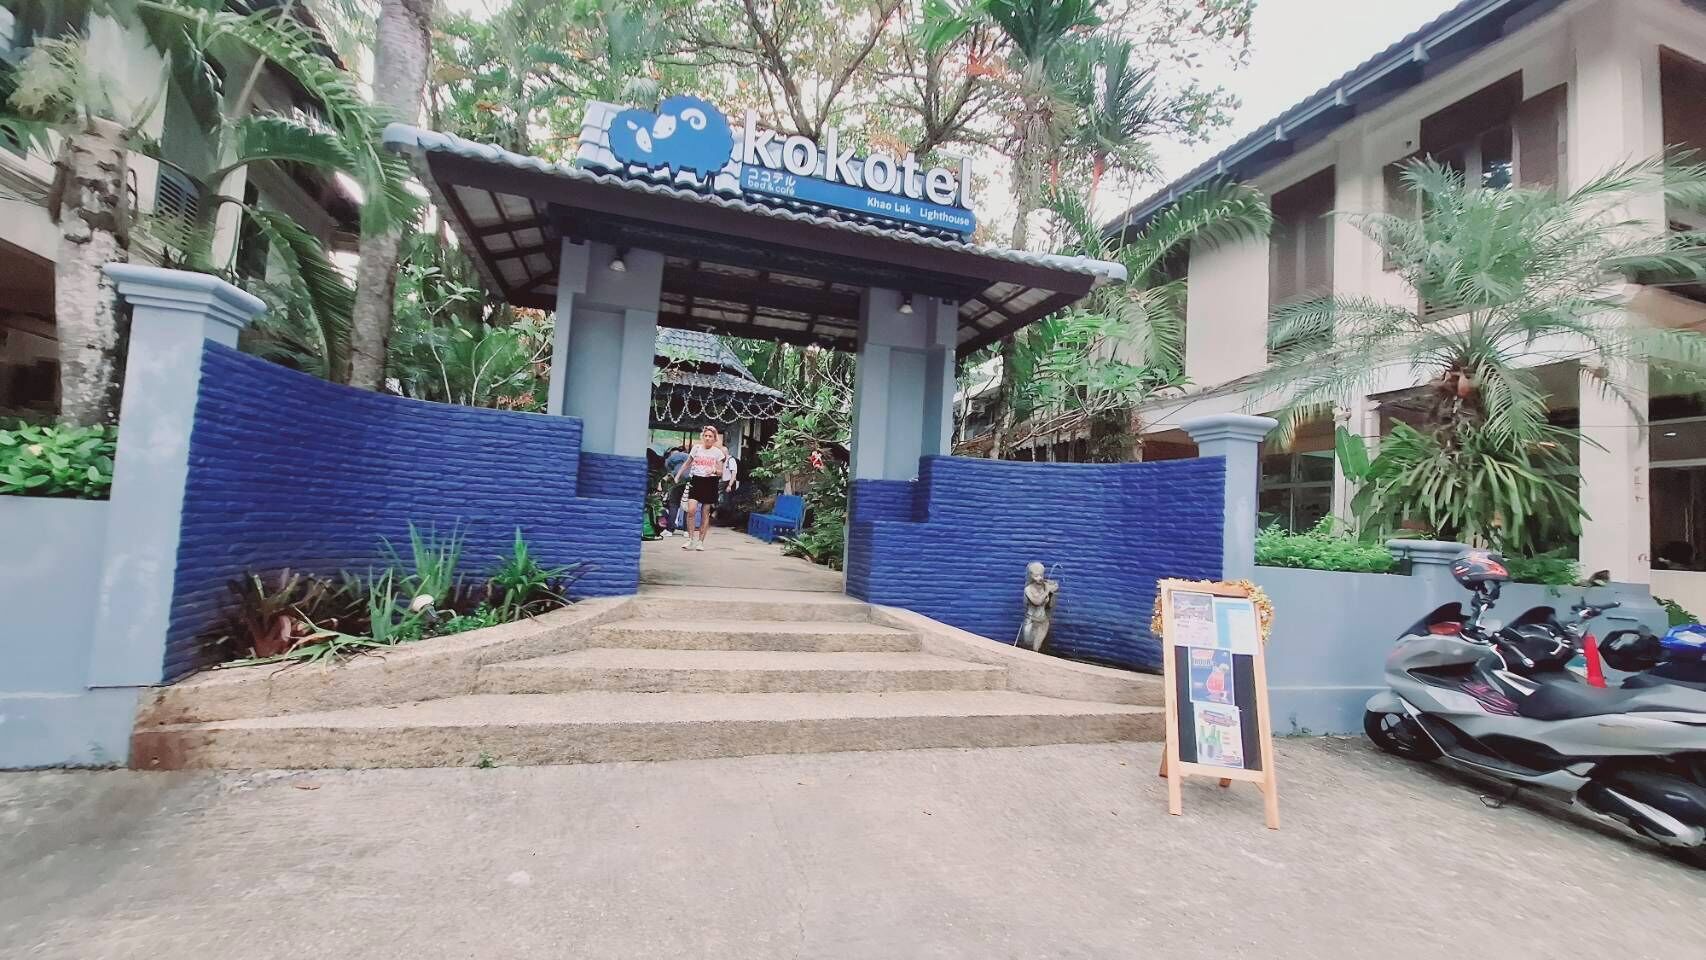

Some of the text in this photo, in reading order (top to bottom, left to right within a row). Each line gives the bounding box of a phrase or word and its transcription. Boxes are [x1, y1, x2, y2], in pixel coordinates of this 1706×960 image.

[744, 109, 974, 209] kokotel
[748, 168, 796, 187] ココテル
[748, 177, 767, 189] bed
[867, 197, 970, 226] Khao Lak Lighthouse
